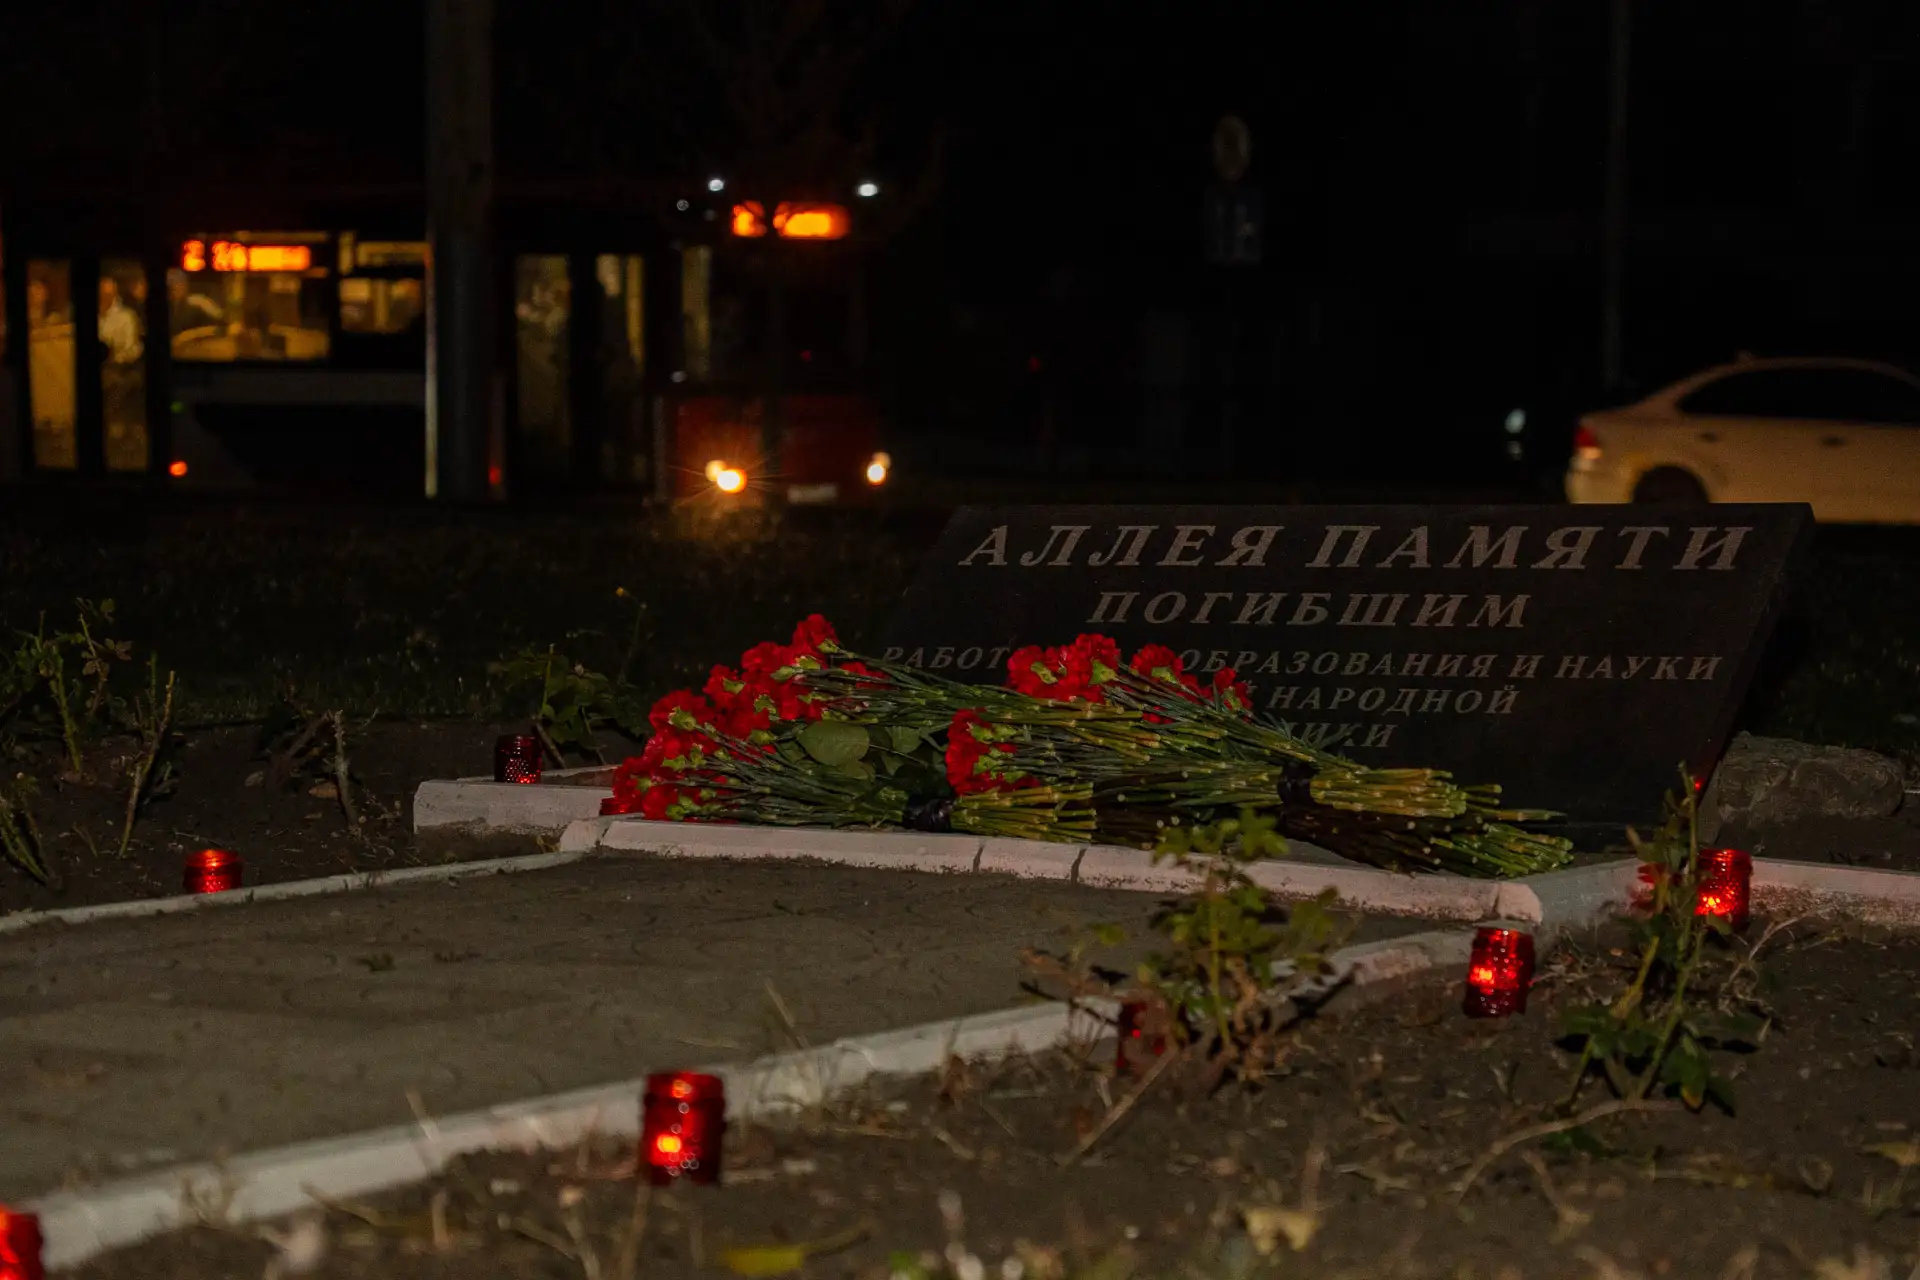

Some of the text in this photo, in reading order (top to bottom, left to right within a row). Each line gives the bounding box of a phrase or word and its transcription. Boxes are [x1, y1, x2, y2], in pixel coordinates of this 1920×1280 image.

[958, 525, 1753, 570] АЛЛЕЯ ПАМЯТИ
[1086, 591, 1531, 627] ПОГИБШИМ
[882, 646, 1009, 669] РАБОТ
[1509, 655, 1544, 678] И
[1554, 656, 1722, 680] НАУКИ
[1265, 685, 1520, 716] НАРОДНОЙ
